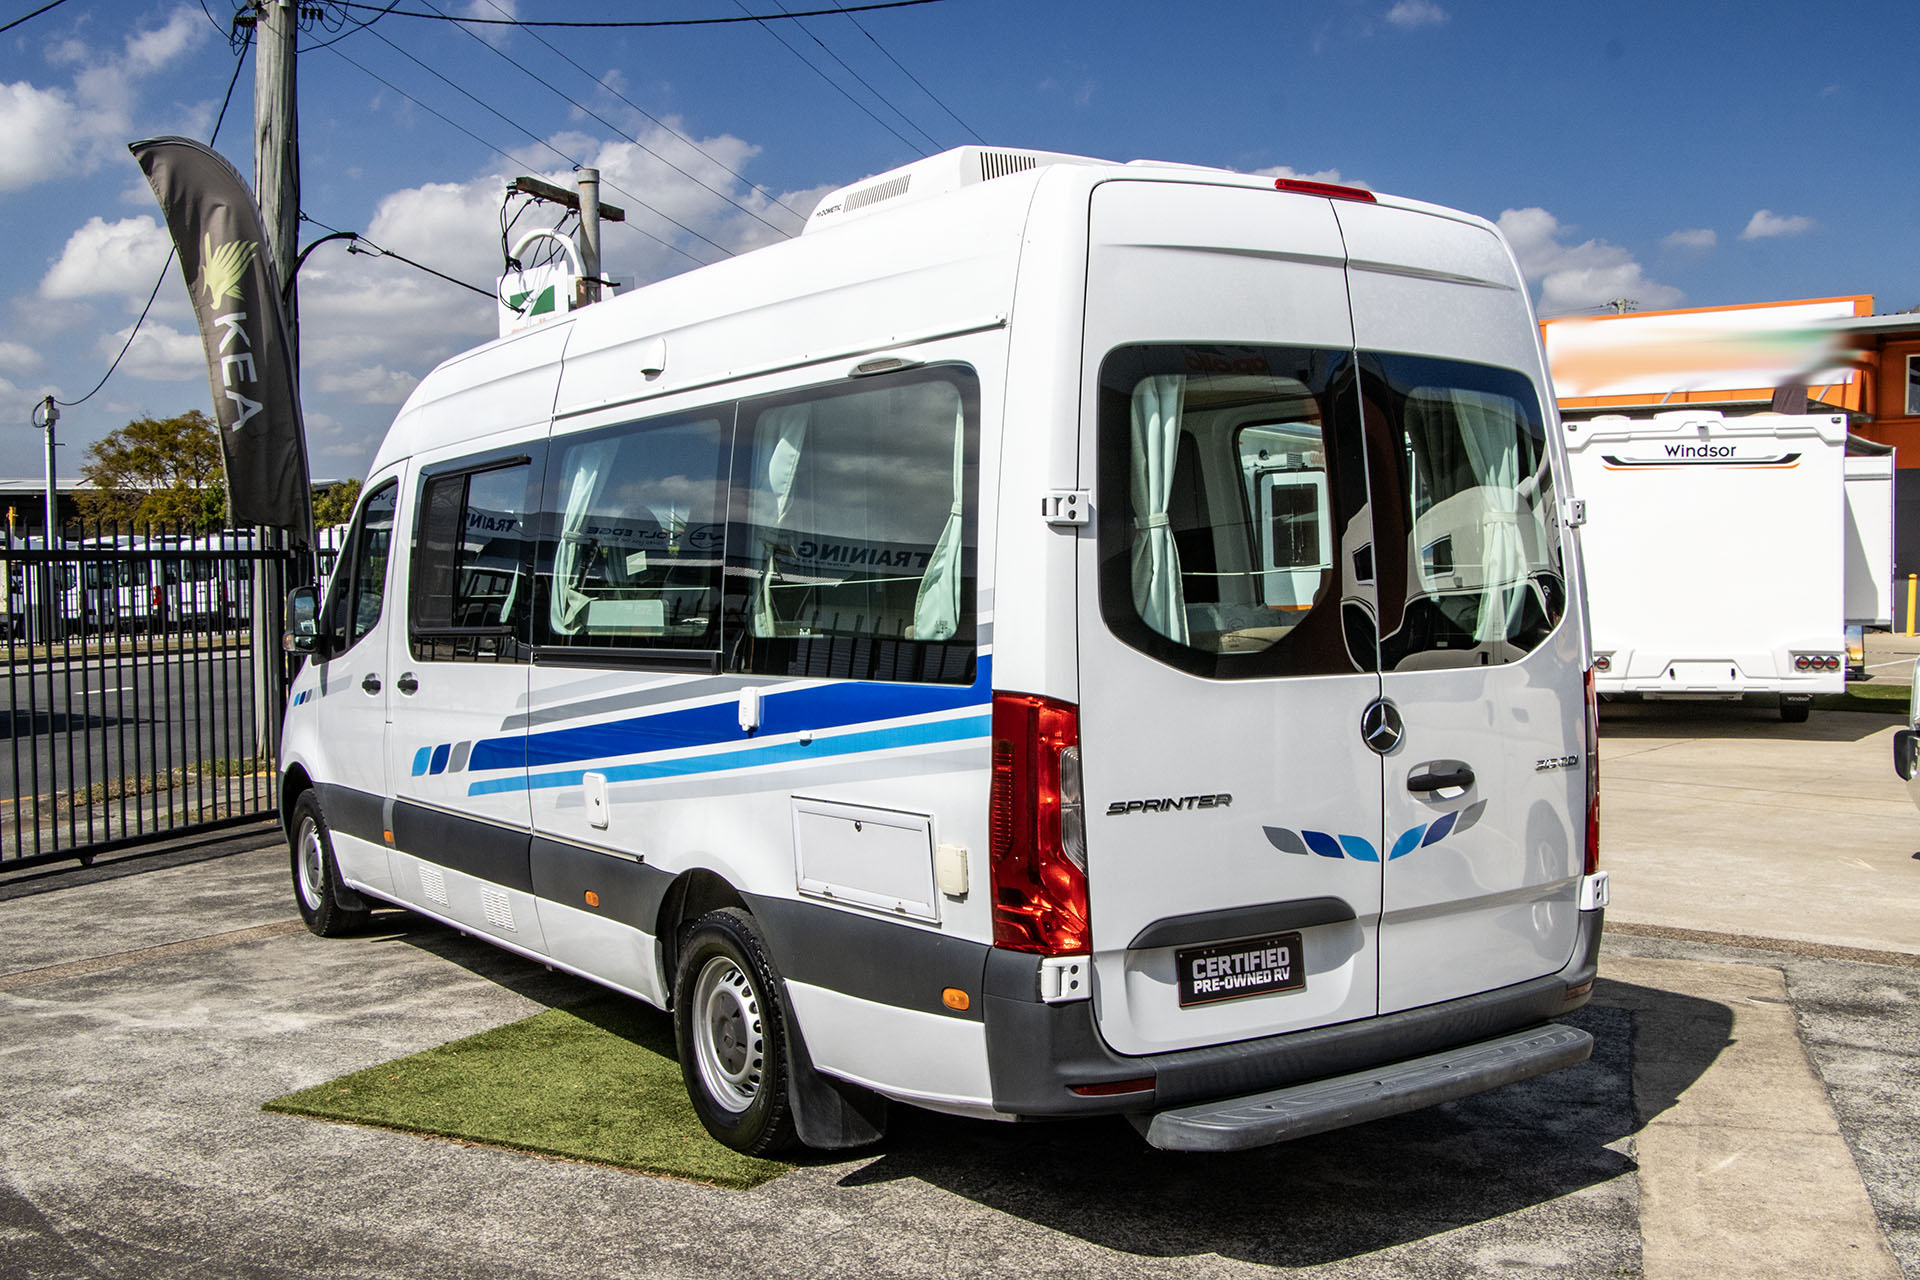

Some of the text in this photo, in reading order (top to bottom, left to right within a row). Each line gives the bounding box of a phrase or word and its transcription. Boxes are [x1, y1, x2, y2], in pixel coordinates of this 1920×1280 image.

[214, 312, 263, 432] KEA
[1665, 444, 1737, 457] Windsor
[1106, 793, 1233, 816] SPRINTER
[1192, 946, 1290, 980] CERTIFIED
[1193, 966, 1291, 994] PRE-OWNED RV
